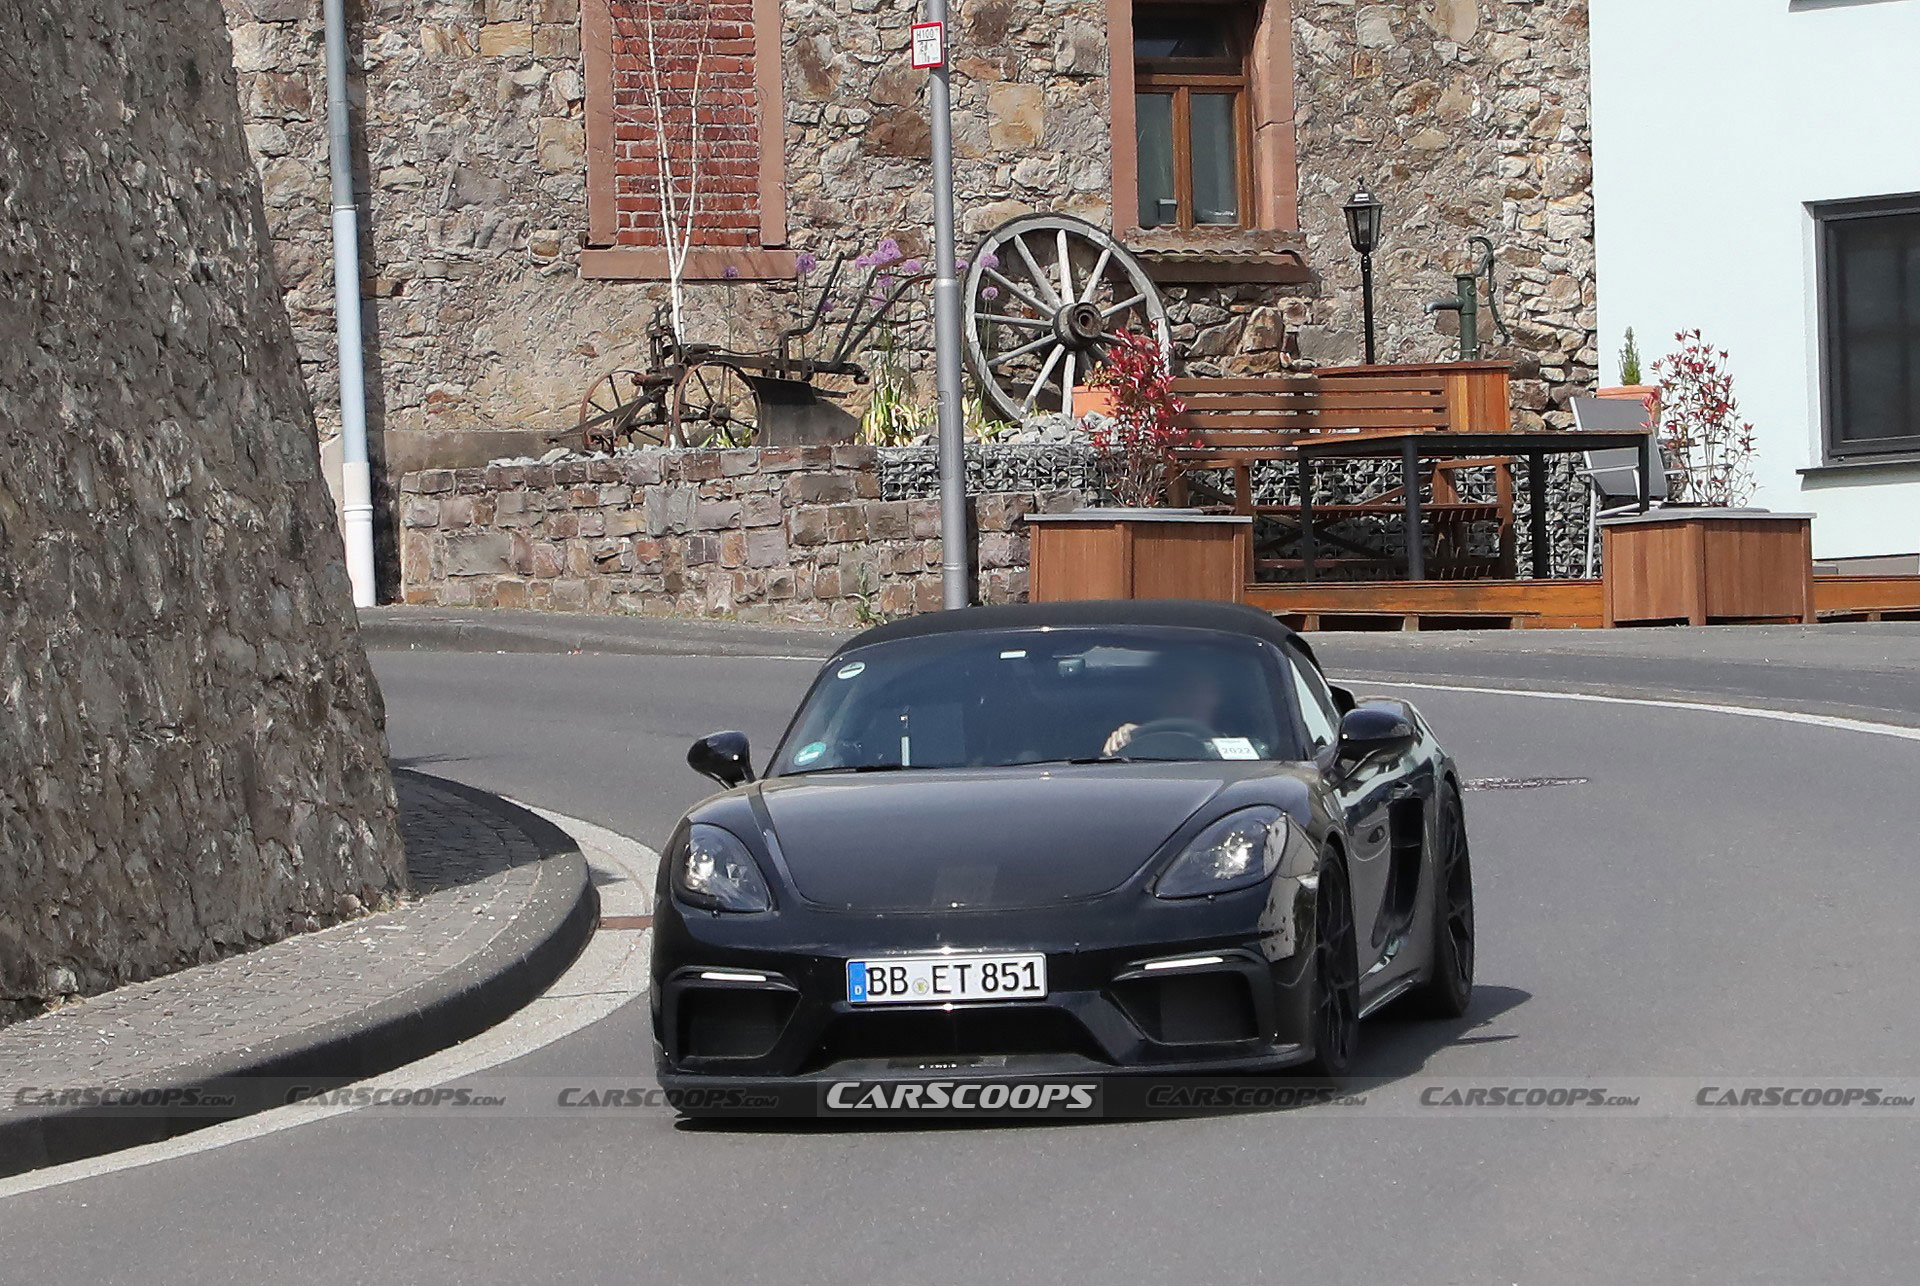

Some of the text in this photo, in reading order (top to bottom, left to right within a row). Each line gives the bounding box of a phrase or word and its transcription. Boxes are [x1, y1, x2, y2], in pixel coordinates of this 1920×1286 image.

[866, 961, 1040, 996] BB ET 851
